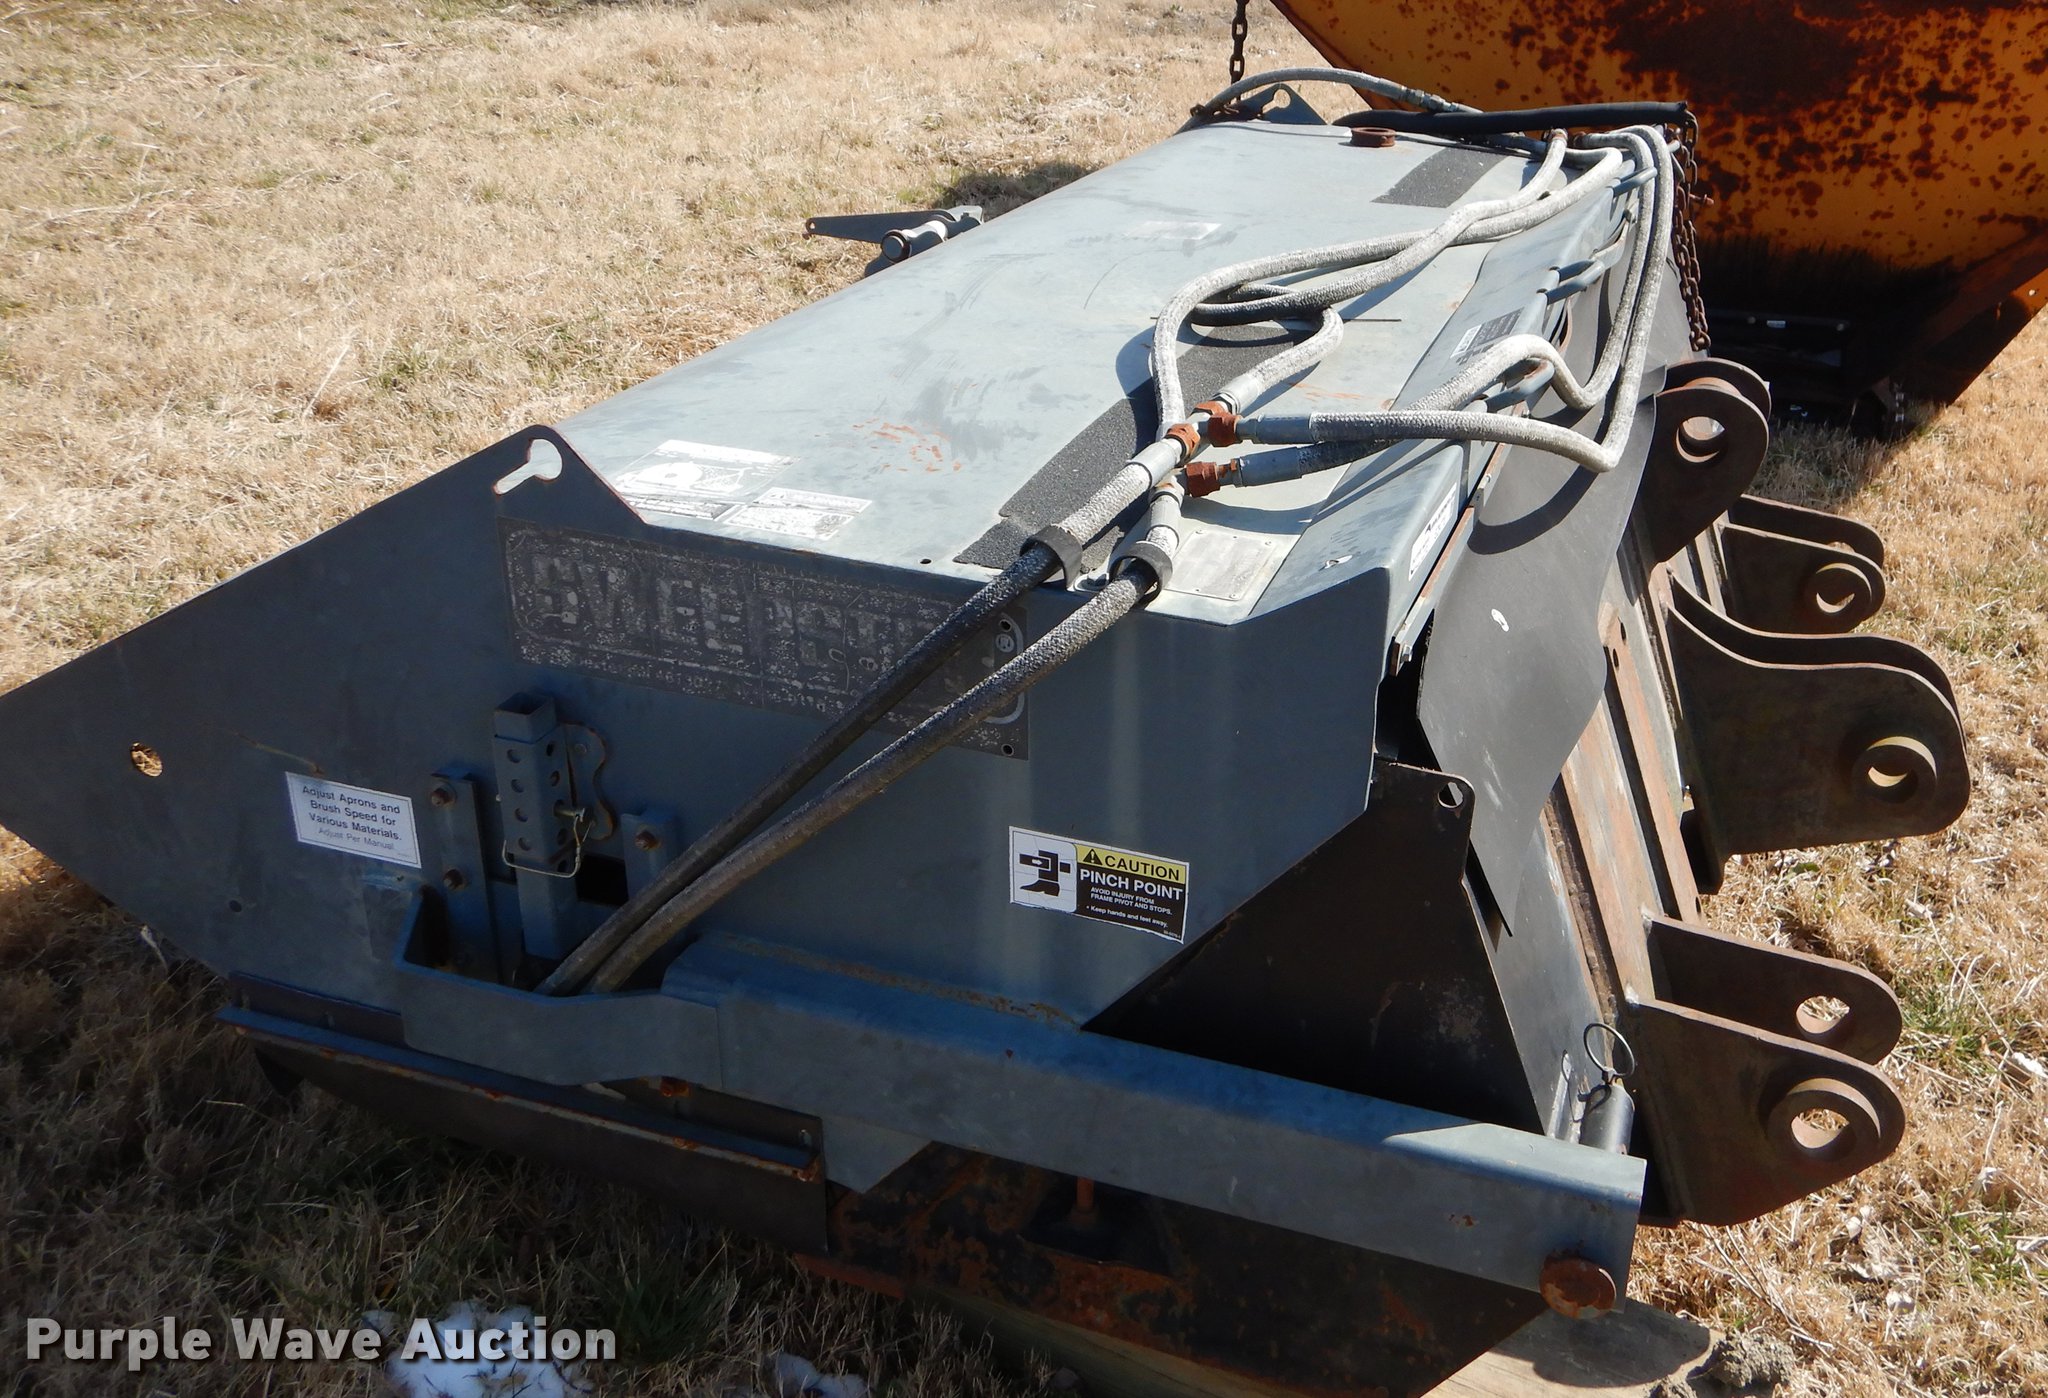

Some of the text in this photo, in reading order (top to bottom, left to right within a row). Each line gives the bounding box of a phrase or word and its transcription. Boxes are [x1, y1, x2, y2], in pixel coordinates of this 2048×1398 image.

[303, 786, 401, 814] Adjust Aprons and
[310, 800, 397, 826] Brush Speed for
[308, 812, 402, 840] Various Materials.
[318, 827, 394, 850] Adjust Per Manual
[1105, 855, 1180, 881] CAUTION
[1080, 868, 1183, 901] PINCH POINT
[1090, 887, 1155, 905] AVOID INJURY FROM
[1090, 893, 1173, 915] FRAME PIVOT AND STOPS.
[1090, 905, 1107, 914] Keep
[1107, 908, 1126, 917] hands
[1139, 915, 1151, 923] feet
[1152, 918, 1168, 928] away.
